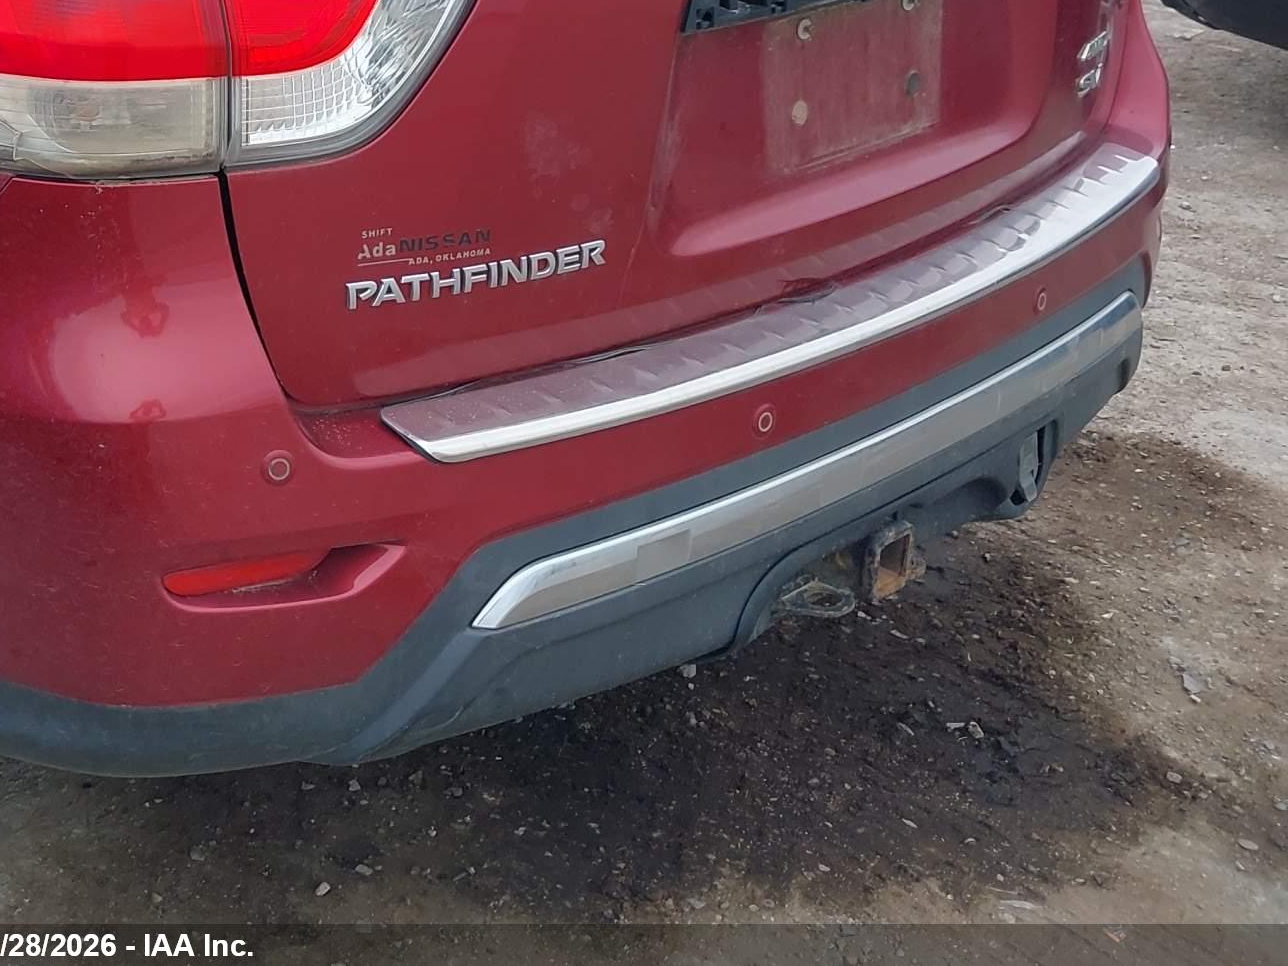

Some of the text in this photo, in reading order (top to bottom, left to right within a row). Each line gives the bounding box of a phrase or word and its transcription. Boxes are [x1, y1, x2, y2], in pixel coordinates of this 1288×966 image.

[361, 227, 393, 239] SHIFT
[408, 247, 491, 266] ADA, OKLAHOMA
[345, 239, 608, 310] PATHFINDER
